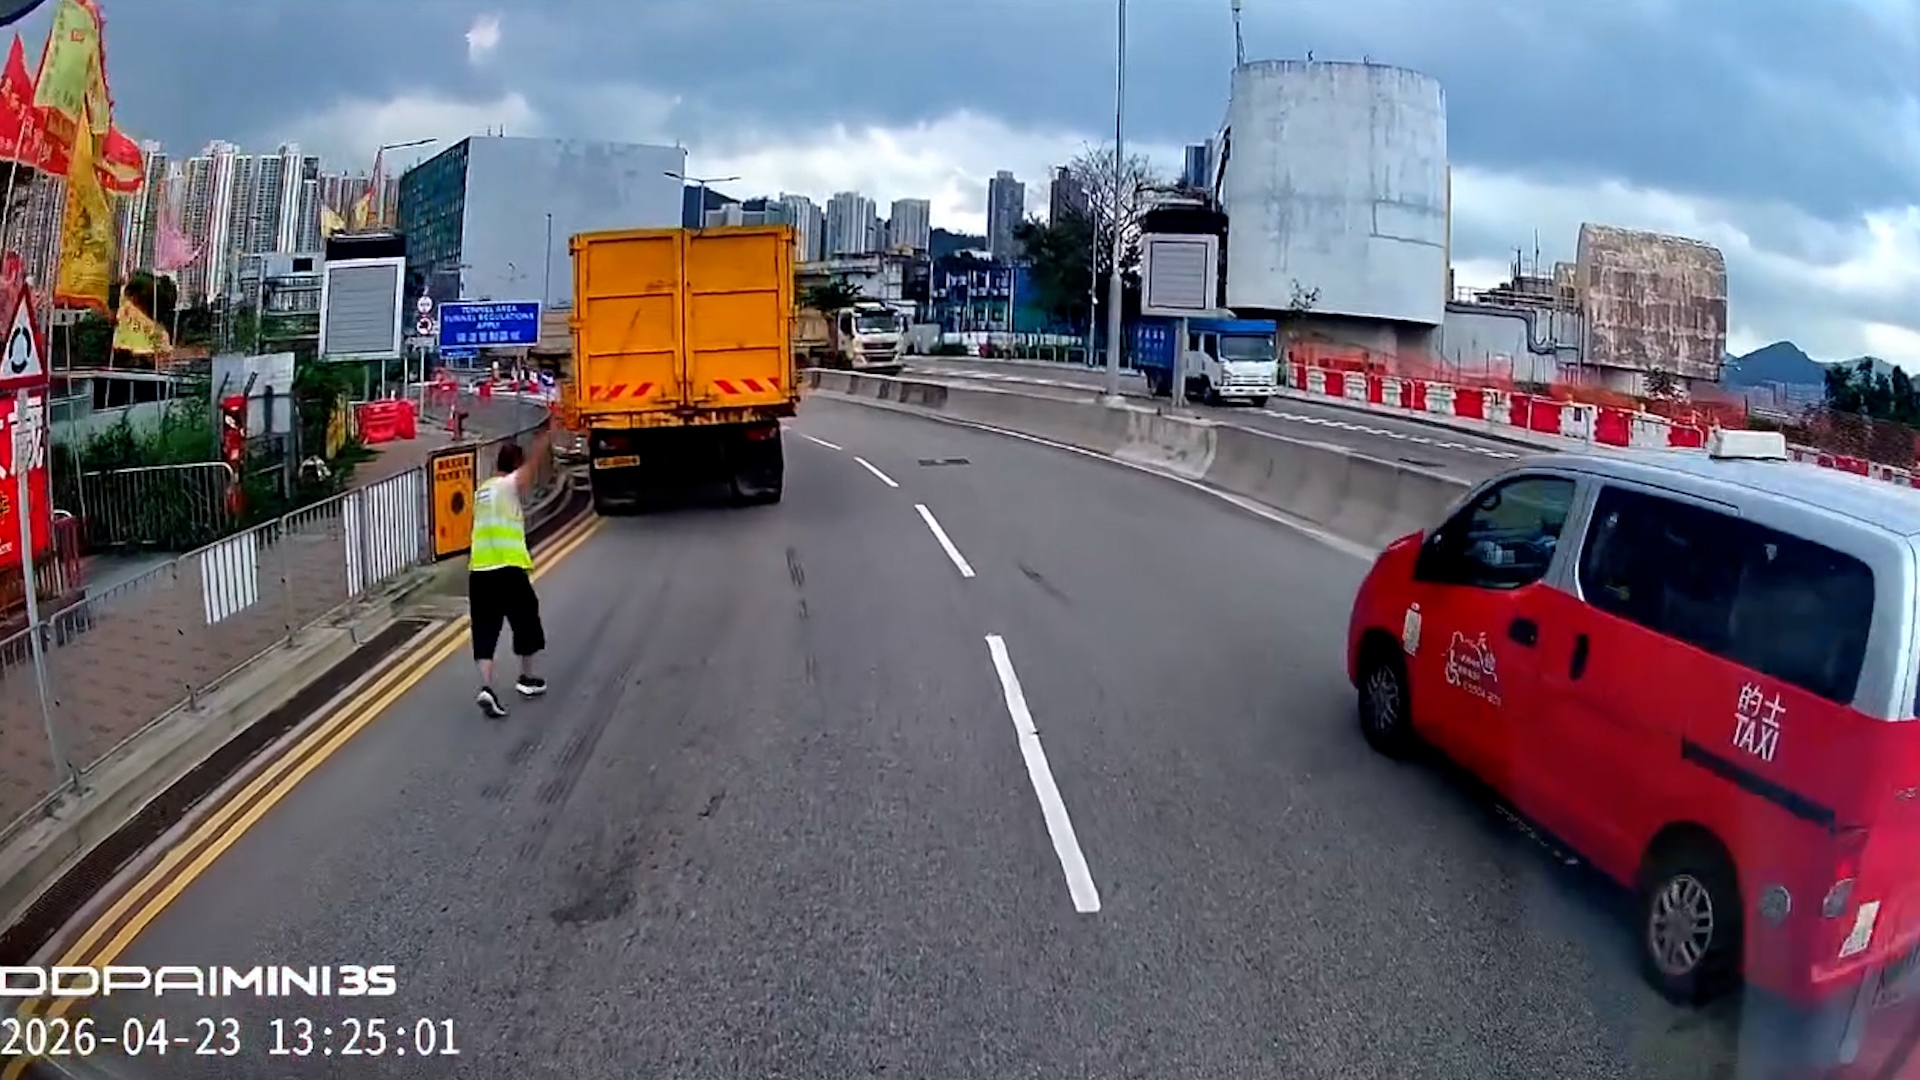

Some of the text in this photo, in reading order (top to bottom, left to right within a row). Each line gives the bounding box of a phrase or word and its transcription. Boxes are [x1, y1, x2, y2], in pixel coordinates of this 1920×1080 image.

[461, 306, 495, 314] TUNNEL
[443, 312, 535, 323] TUNNEL REGULATIONS
[475, 321, 501, 329] APPLY
[1737, 681, 1787, 729] 的士
[1732, 712, 1780, 762] TAXI
